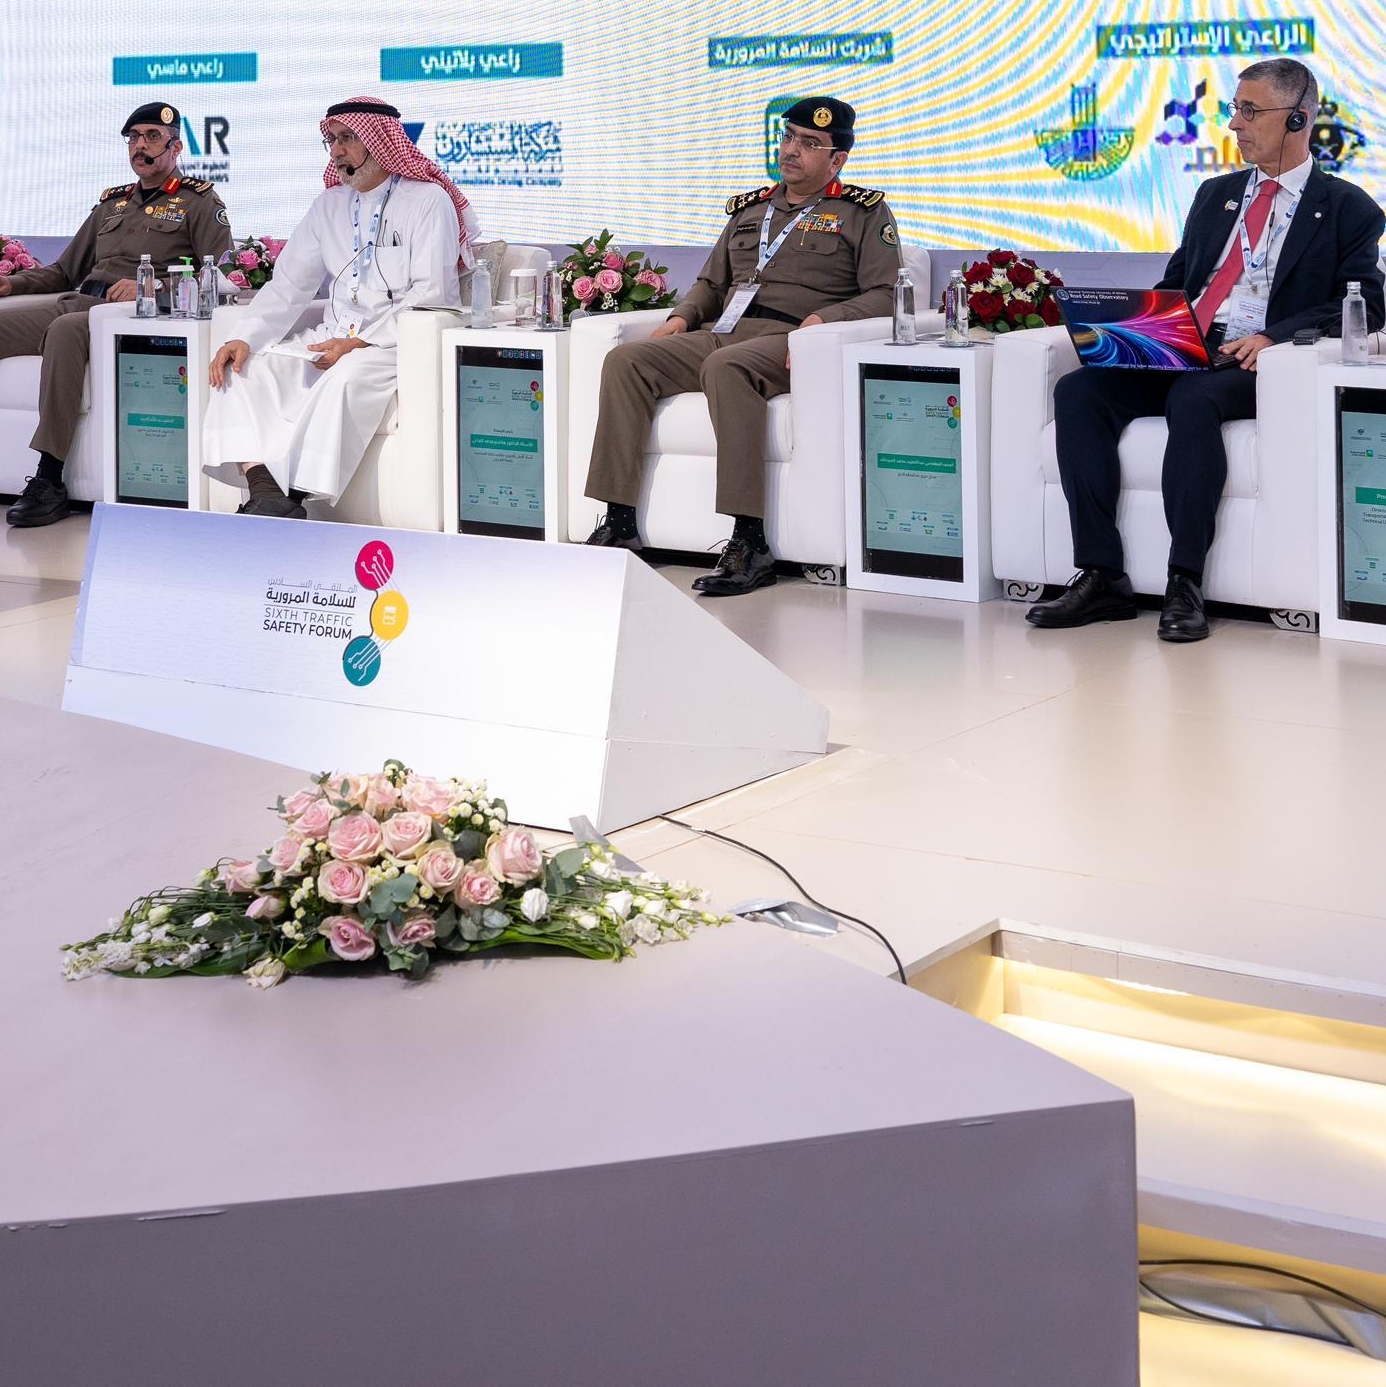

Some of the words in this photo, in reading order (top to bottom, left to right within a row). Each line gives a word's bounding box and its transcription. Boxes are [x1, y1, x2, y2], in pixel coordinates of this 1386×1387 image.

[1235, 22, 1308, 53] الراعي
[190, 57, 224, 79] راعي
[478, 47, 521, 73] راعي
[266, 587, 310, 605] المرورية
[312, 591, 356, 608] للسلامة
[264, 607, 298, 621] SIXTH
[303, 611, 353, 627] TRAFFIC
[263, 619, 307, 635] SAFETY
[308, 624, 352, 640] FORUM
